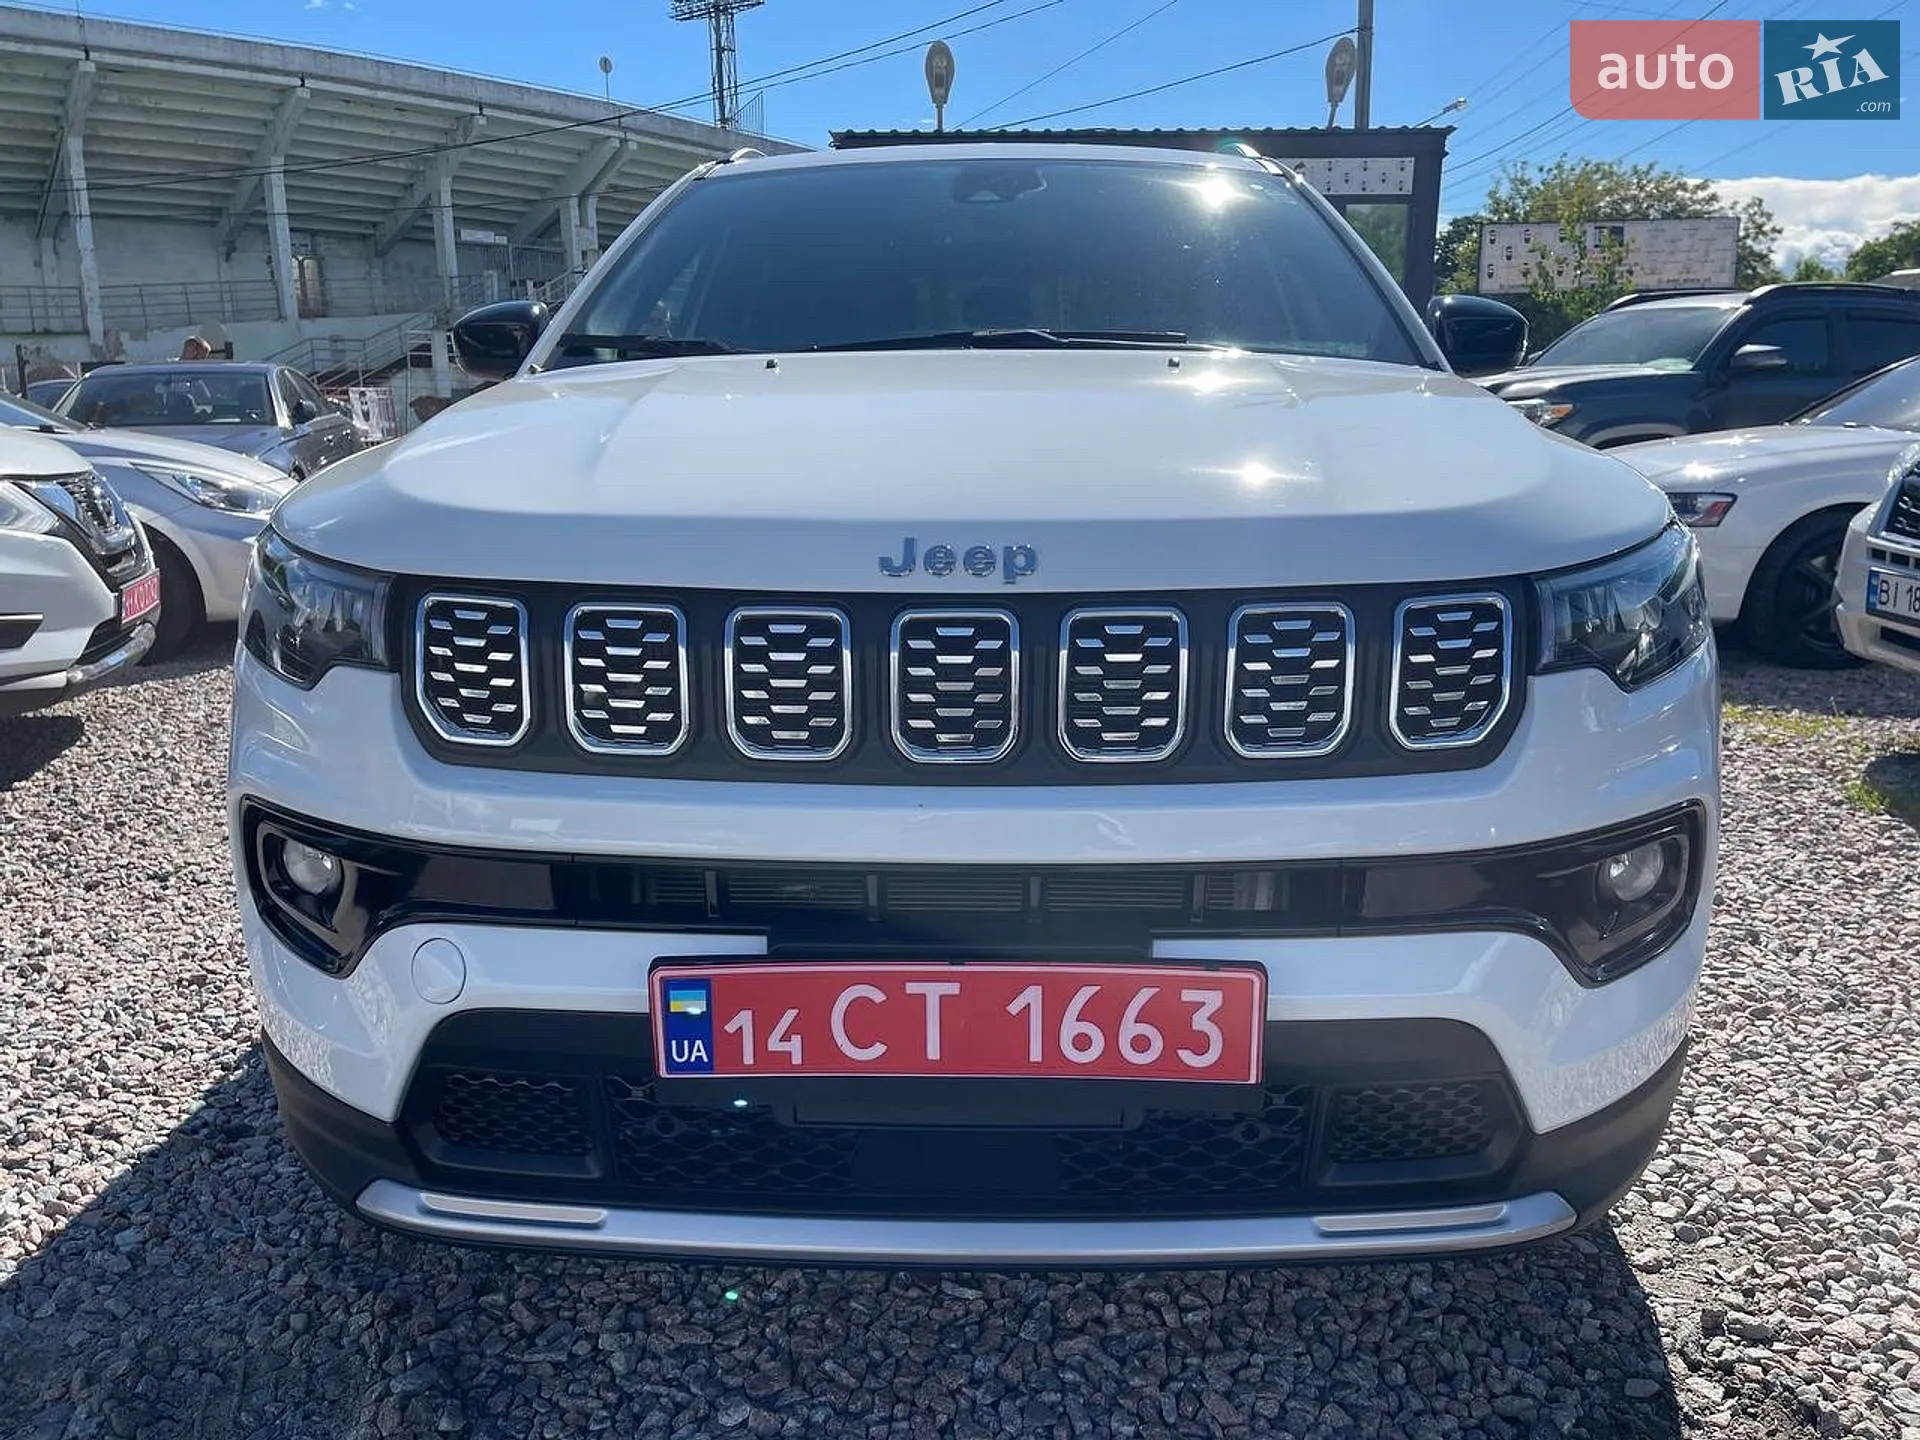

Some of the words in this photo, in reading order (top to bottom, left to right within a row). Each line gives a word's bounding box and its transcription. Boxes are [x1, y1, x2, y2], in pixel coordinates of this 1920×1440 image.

[878, 537, 1038, 584] Jeep
[1878, 579, 1899, 609] BI
[723, 1009, 803, 1065] 14
[831, 982, 961, 1061] CT
[1005, 985, 1223, 1068] 1663
[671, 1040, 709, 1062] UA
